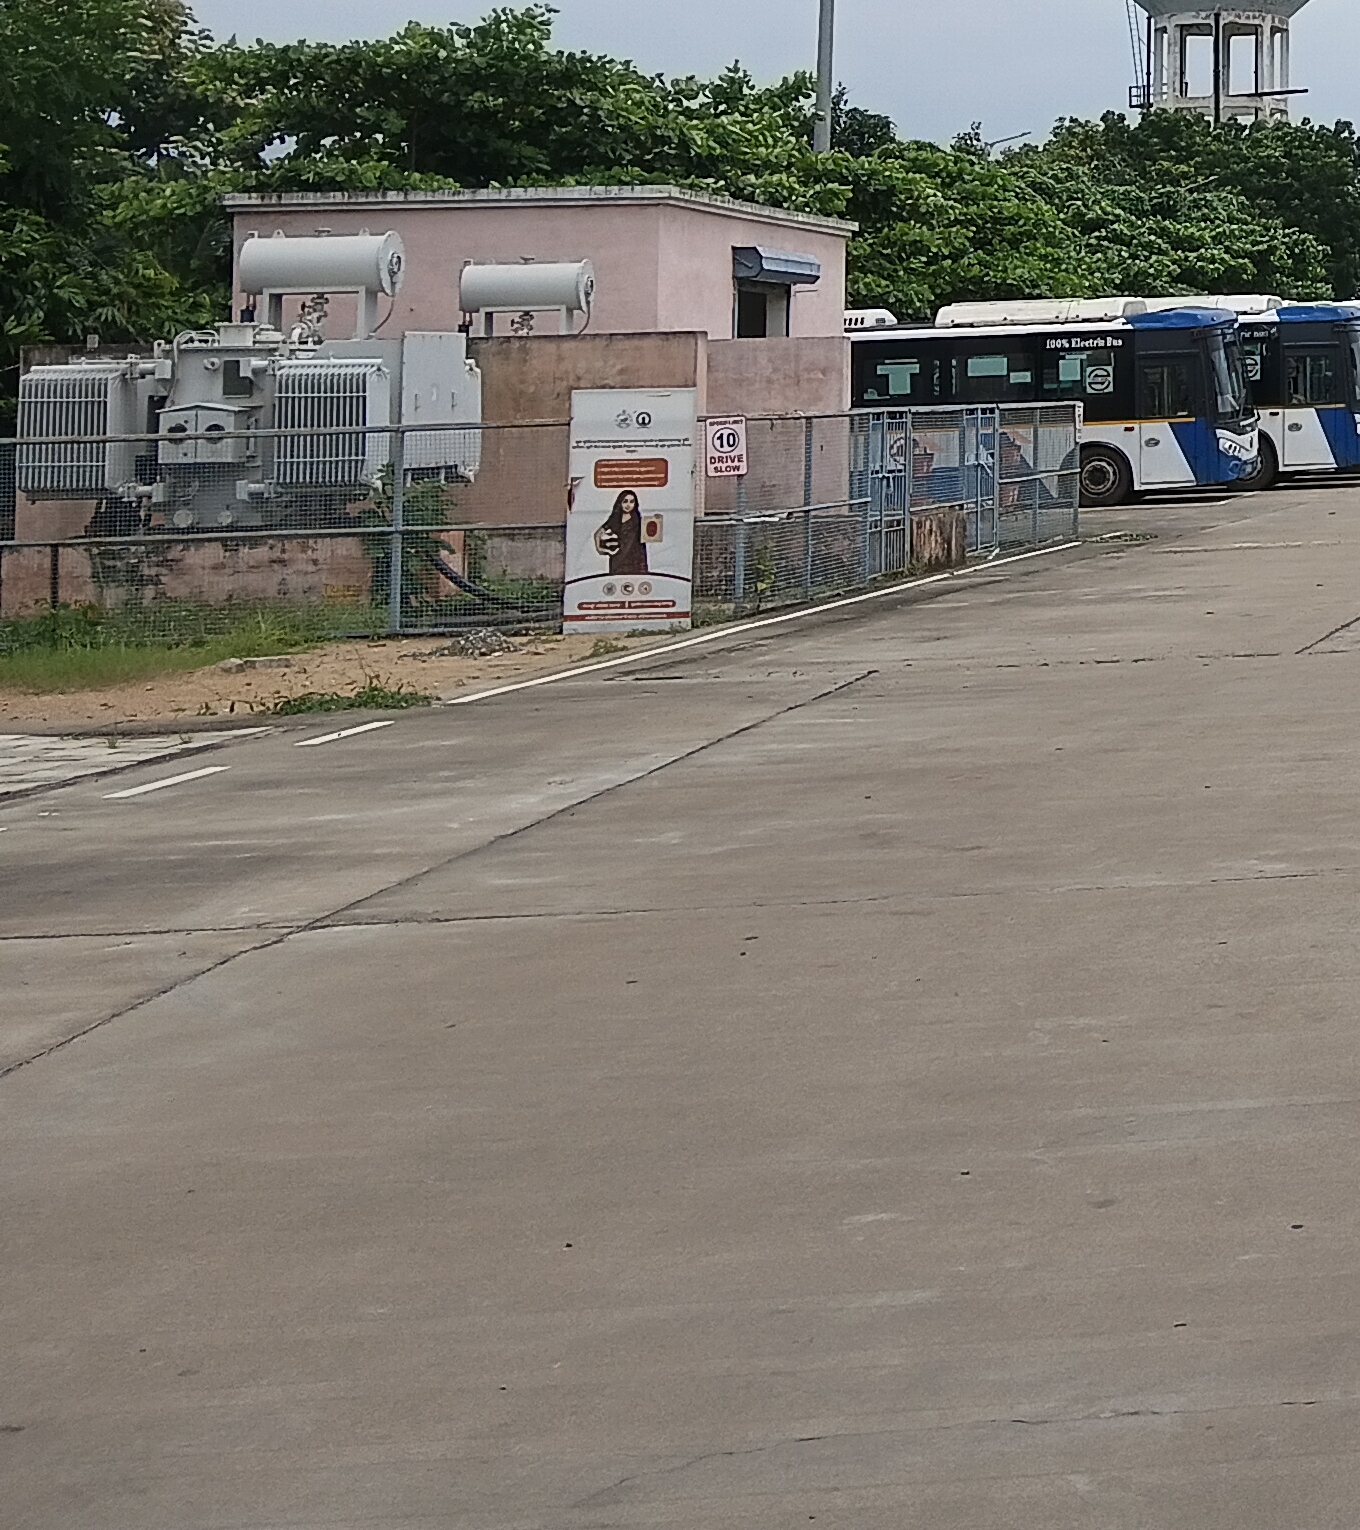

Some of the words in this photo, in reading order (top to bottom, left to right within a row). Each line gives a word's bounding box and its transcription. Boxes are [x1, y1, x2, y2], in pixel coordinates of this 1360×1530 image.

[1046, 338, 1070, 349] 100%
[1106, 336, 1123, 347] Bus
[716, 432, 737, 449] 10
[709, 453, 745, 465] DRIVE
[713, 464, 741, 474] SLOW
